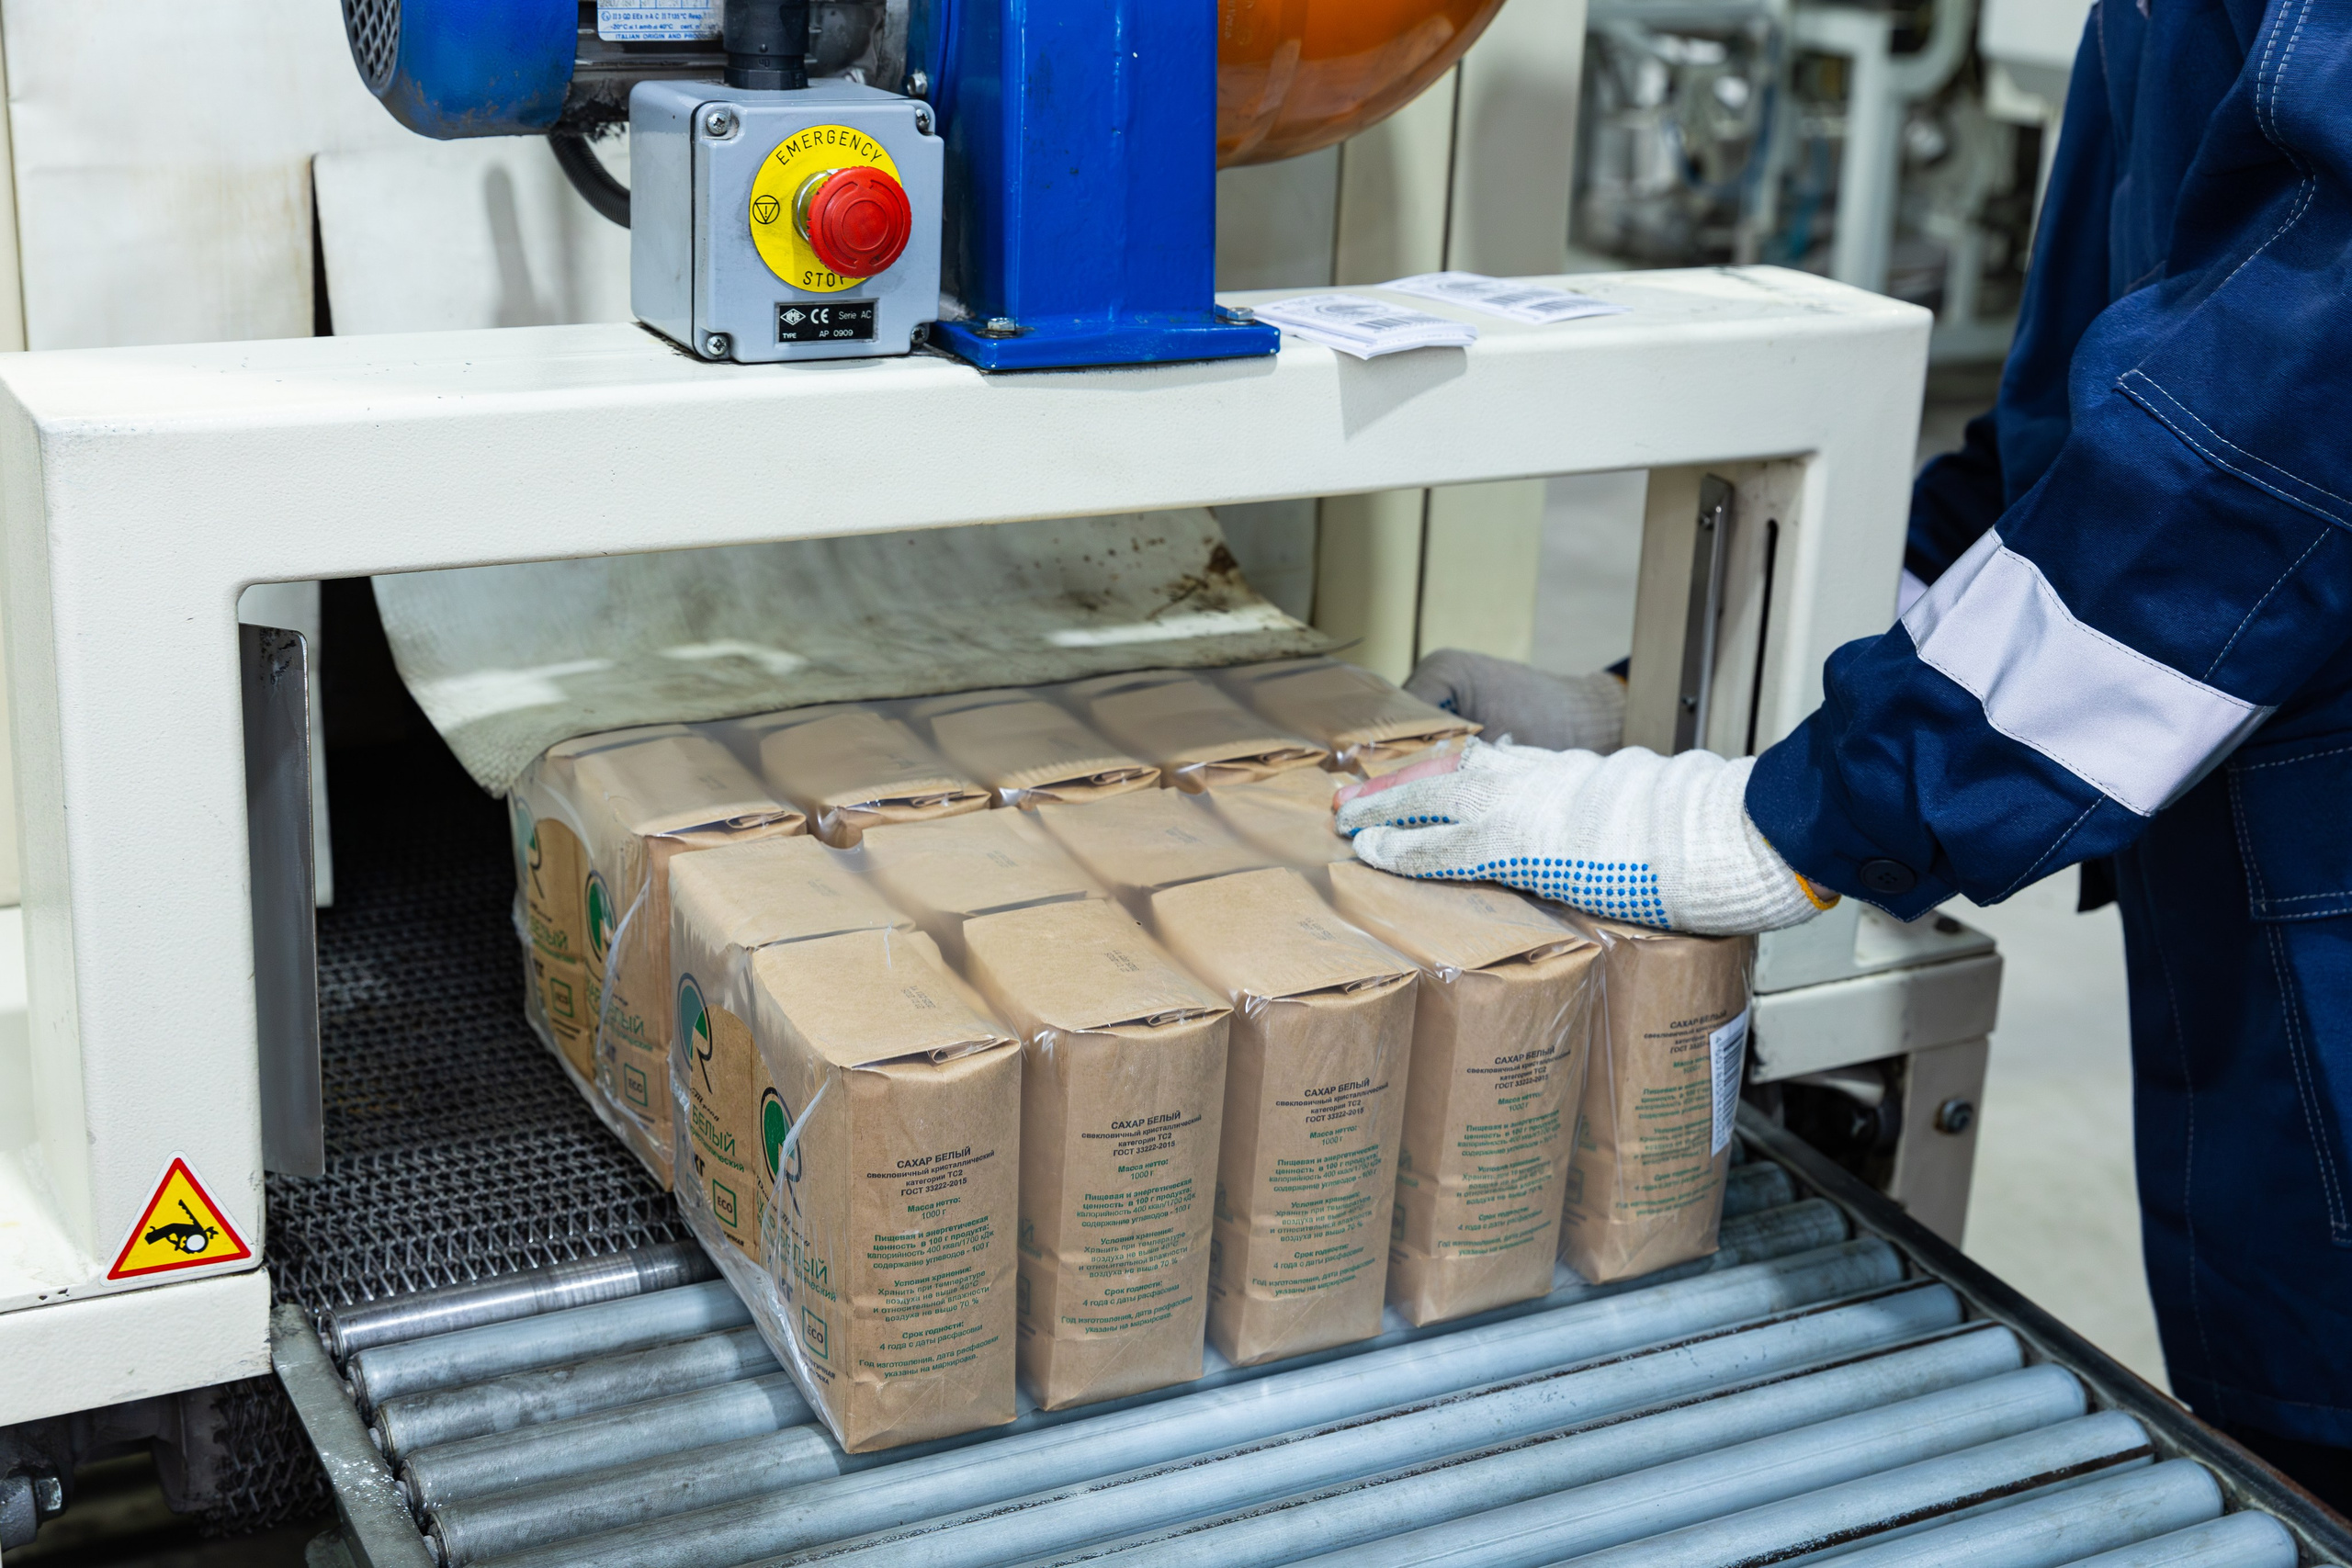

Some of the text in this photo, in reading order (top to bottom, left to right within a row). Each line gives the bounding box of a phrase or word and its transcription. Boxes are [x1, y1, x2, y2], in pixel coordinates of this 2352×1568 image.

[775, 130, 882, 165] EMERGENCY
[838, 310, 856, 320] Serie
[861, 310, 872, 319] AC
[833, 329, 854, 337] 0909
[1495, 1055, 1524, 1065] САХАР
[1304, 1077, 1370, 1097] САХАР БЕЛЫЙ
[1111, 1111, 1182, 1130] САХАР БЕЛЫЙ
[1306, 1115, 1326, 1123] ГОСТ
[692, 1104, 736, 1156] БЕЛЫЙ
[1118, 1137, 1156, 1147] категории
[897, 1145, 971, 1168] САХАР БЕЛЫЙ
[866, 1168, 929, 1179] свекловичный
[1131, 1171, 1148, 1181] 1000
[900, 1177, 967, 1196] ГОСТ 33222-2015
[906, 1175, 945, 1187] категории
[717, 1195, 733, 1213] ECO
[907, 1197, 961, 1213] Масса нетто:
[922, 1210, 941, 1220] 1000
[873, 1244, 916, 1252] ценность
[929, 1237, 943, 1246] 100
[950, 1224, 989, 1240] продукта:
[875, 1234, 916, 1242] Пищевая
[867, 1250, 924, 1259] калорийность
[926, 1245, 941, 1254] 400
[873, 1259, 923, 1269] содержание
[972, 1243, 984, 1252] 100
[894, 1277, 930, 1287] Условия
[917, 1284, 932, 1293] при
[1104, 1289, 1125, 1297] Срок
[885, 1313, 920, 1322] воздуха
[959, 1301, 970, 1310] 70
[807, 1325, 824, 1344] ECO
[902, 1331, 923, 1340] Срок
[888, 1342, 907, 1350] года
[915, 1337, 936, 1348] даты
[859, 1359, 875, 1368] Год
[936, 1351, 955, 1361] дата
[884, 1369, 918, 1379] указаны
